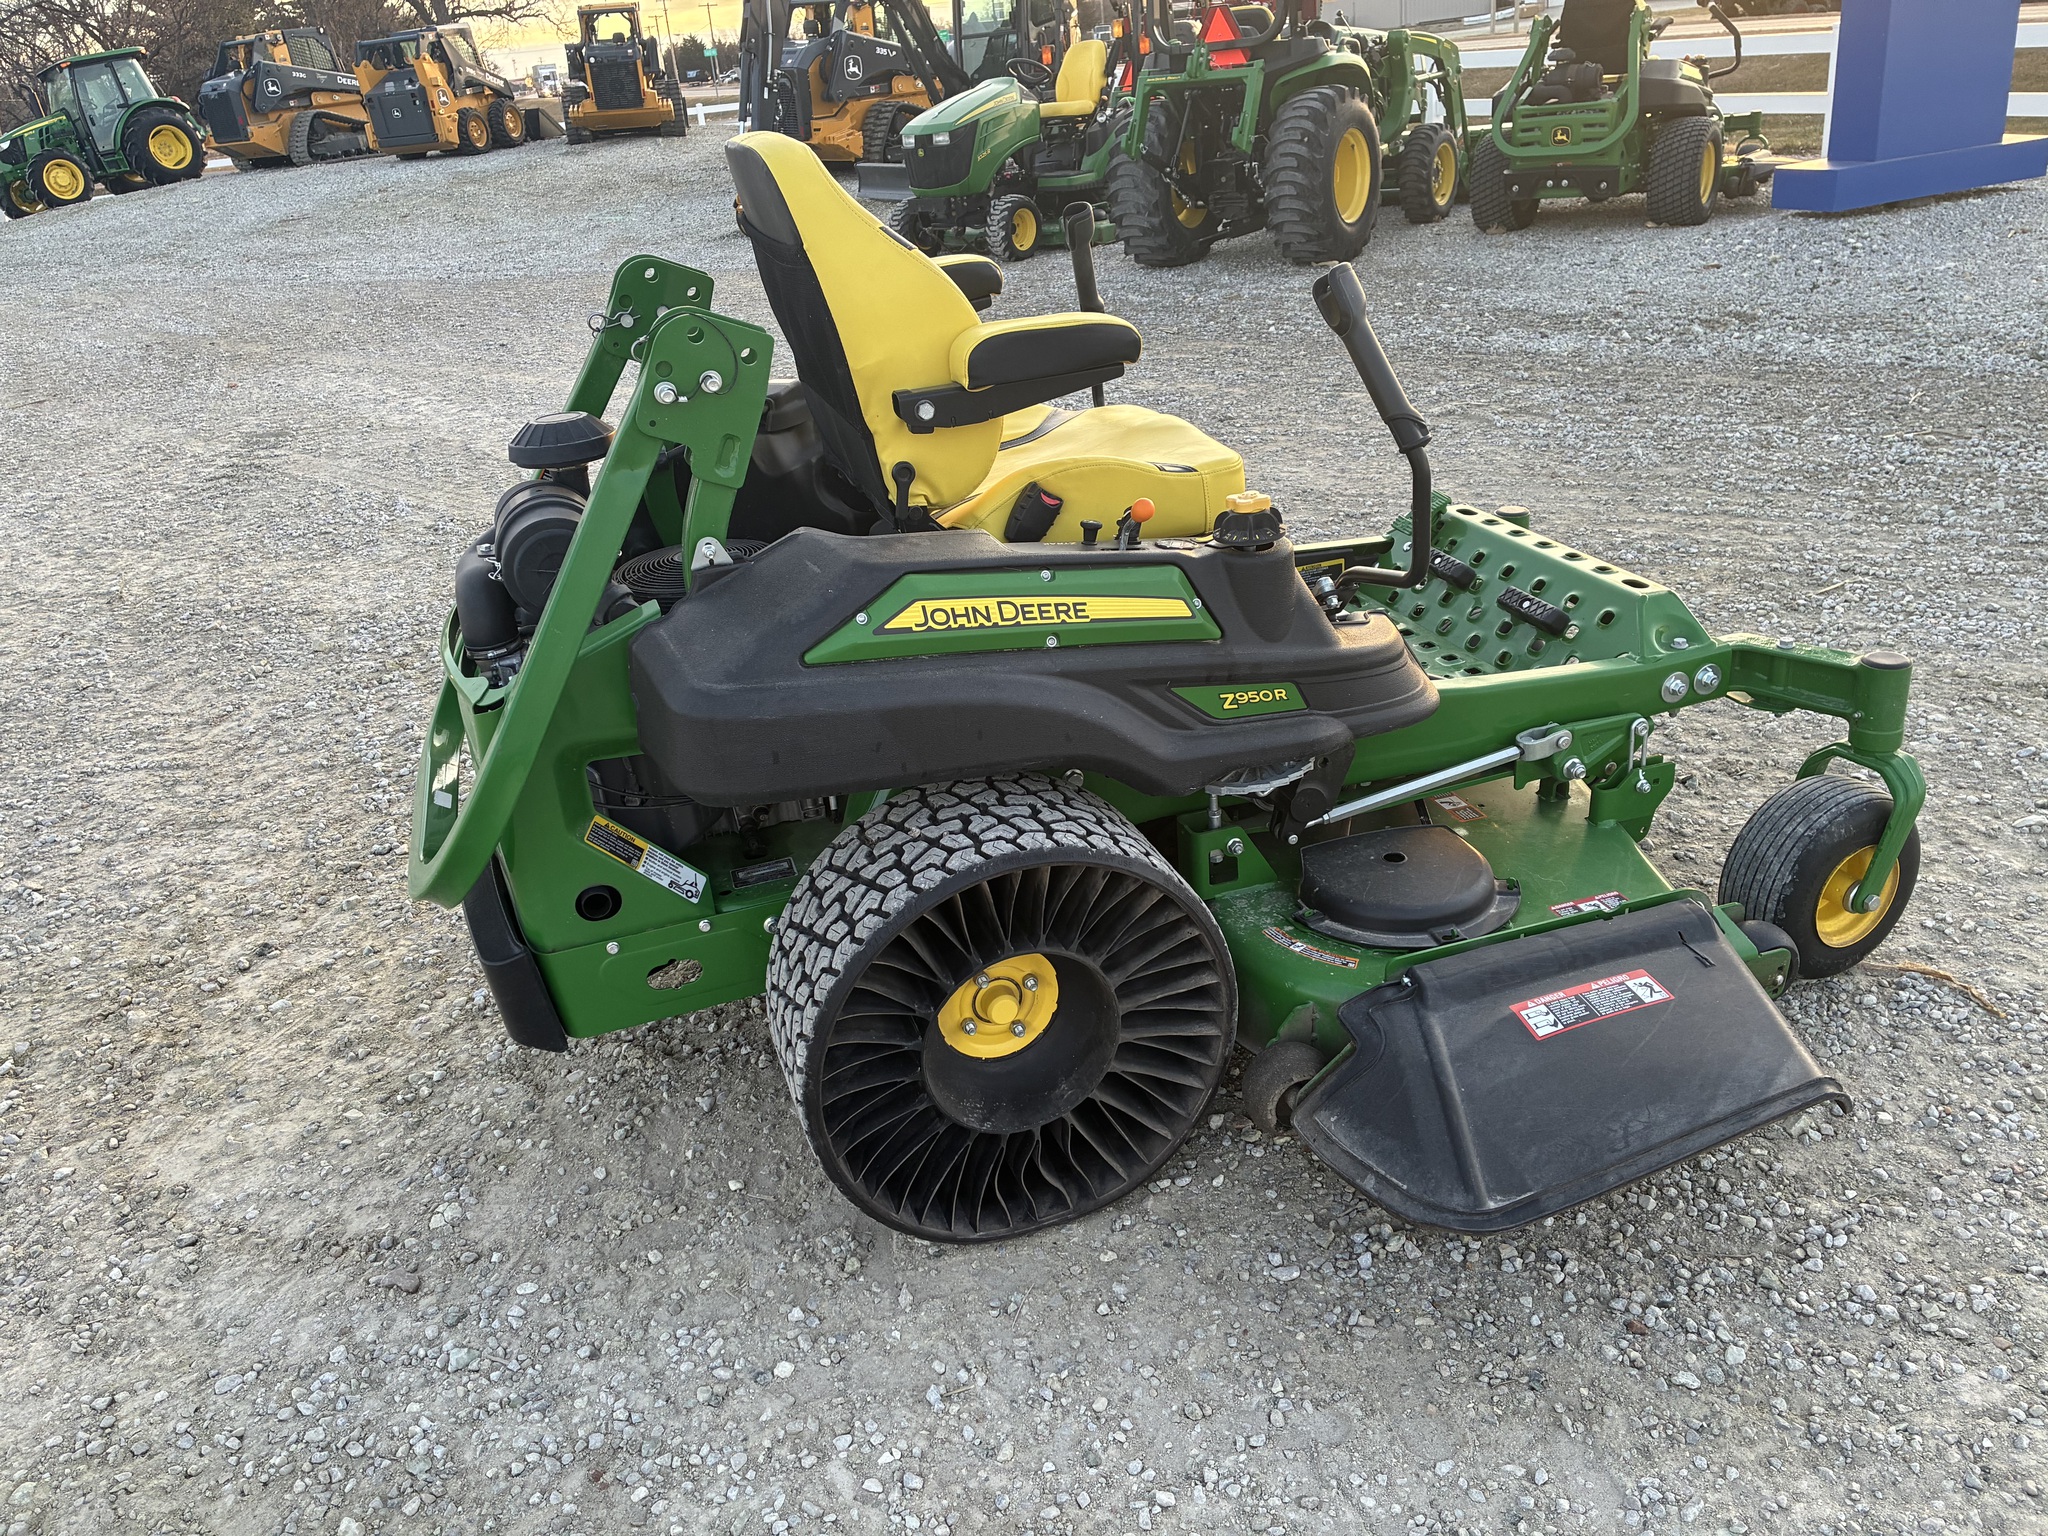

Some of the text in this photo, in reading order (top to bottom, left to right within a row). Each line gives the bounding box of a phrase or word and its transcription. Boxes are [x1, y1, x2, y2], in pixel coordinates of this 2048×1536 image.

[914, 600, 1090, 628] JOHN DEERE
[1219, 688, 1288, 710] Z950R
[610, 825, 636, 843] CAUTION
[1534, 991, 1567, 1004] DANGER
[1597, 974, 1630, 987] PELIGRO
